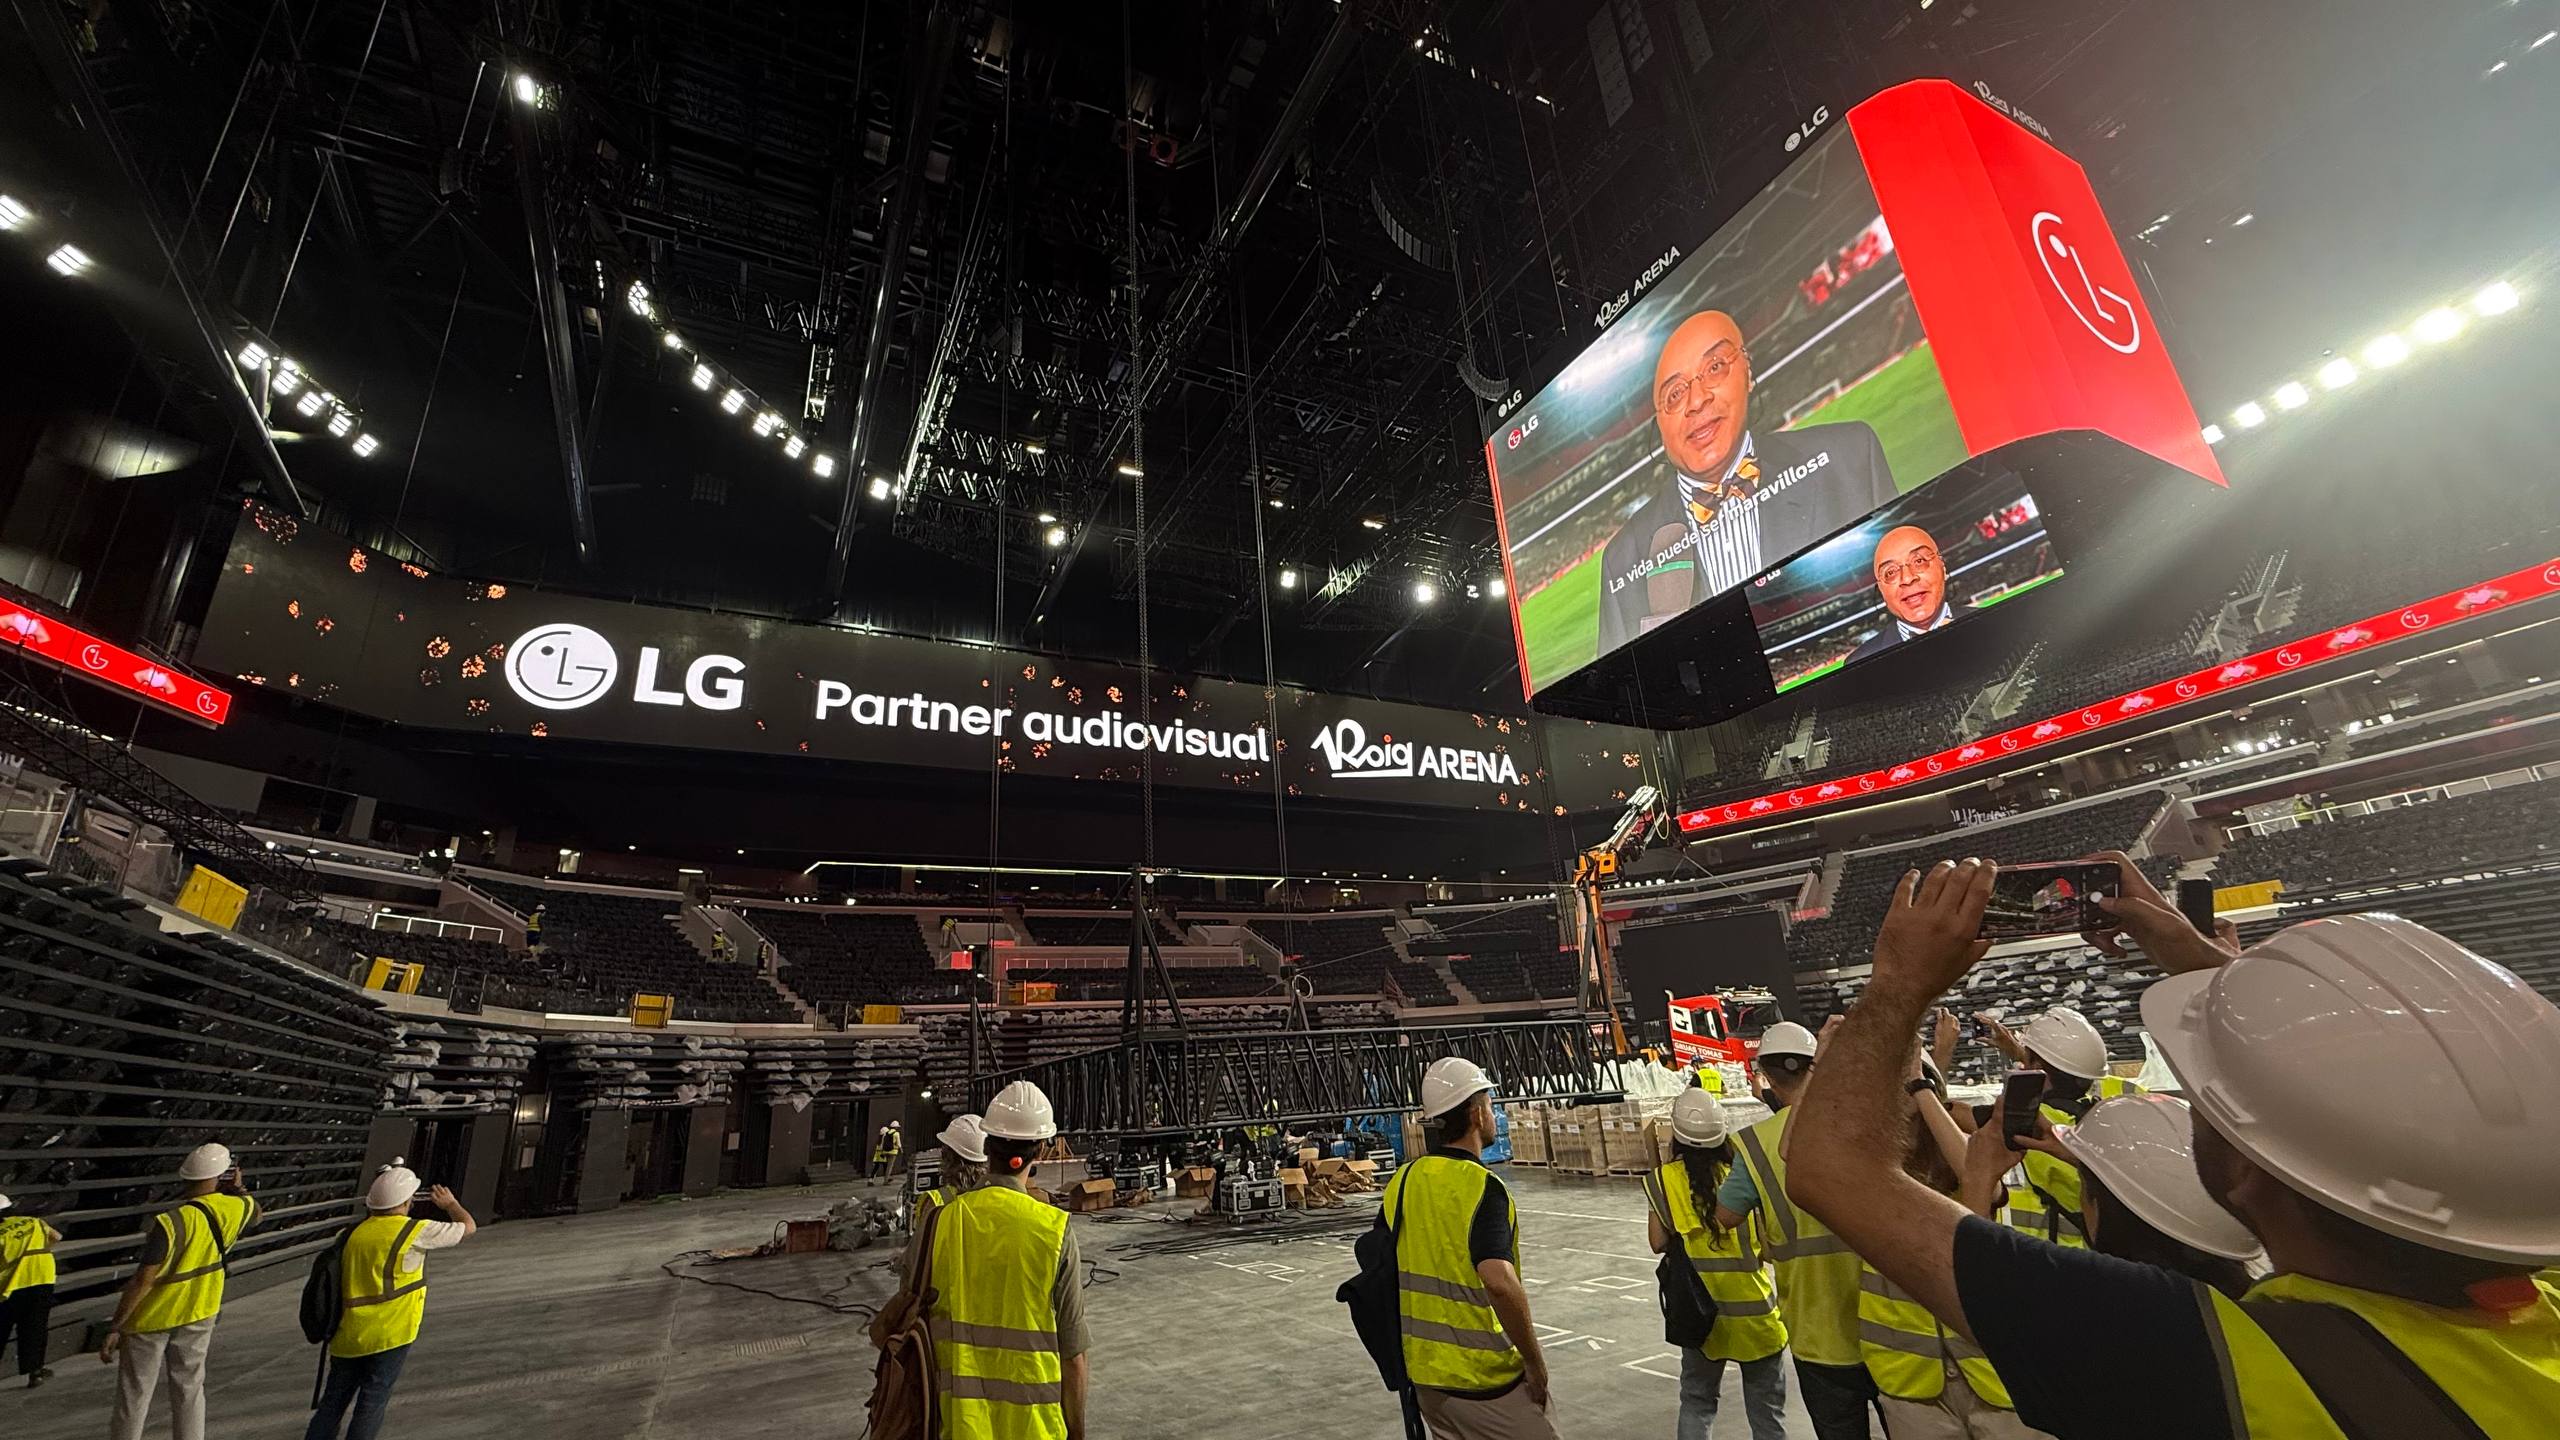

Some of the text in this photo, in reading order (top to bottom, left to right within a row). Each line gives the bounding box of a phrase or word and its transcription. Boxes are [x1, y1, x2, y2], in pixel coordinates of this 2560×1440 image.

[1800, 105, 1829, 138] LG
[2012, 106, 2053, 141] ARENA
[1633, 246, 1680, 296] ARENA
[1507, 389, 1522, 410] LG
[1521, 414, 1539, 438] LG
[1609, 577, 1625, 594] La
[1627, 559, 1654, 583] vida
[1657, 530, 1700, 570] puede
[1727, 450, 1830, 521] maravillosa
[634, 646, 746, 710] LG
[815, 679, 1011, 737] Partner
[1022, 705, 1270, 762] audiovisual
[1310, 719, 1413, 778] Roig
[1418, 746, 1520, 785] ARENA
[1698, 1047, 1723, 1059] TOMAS
